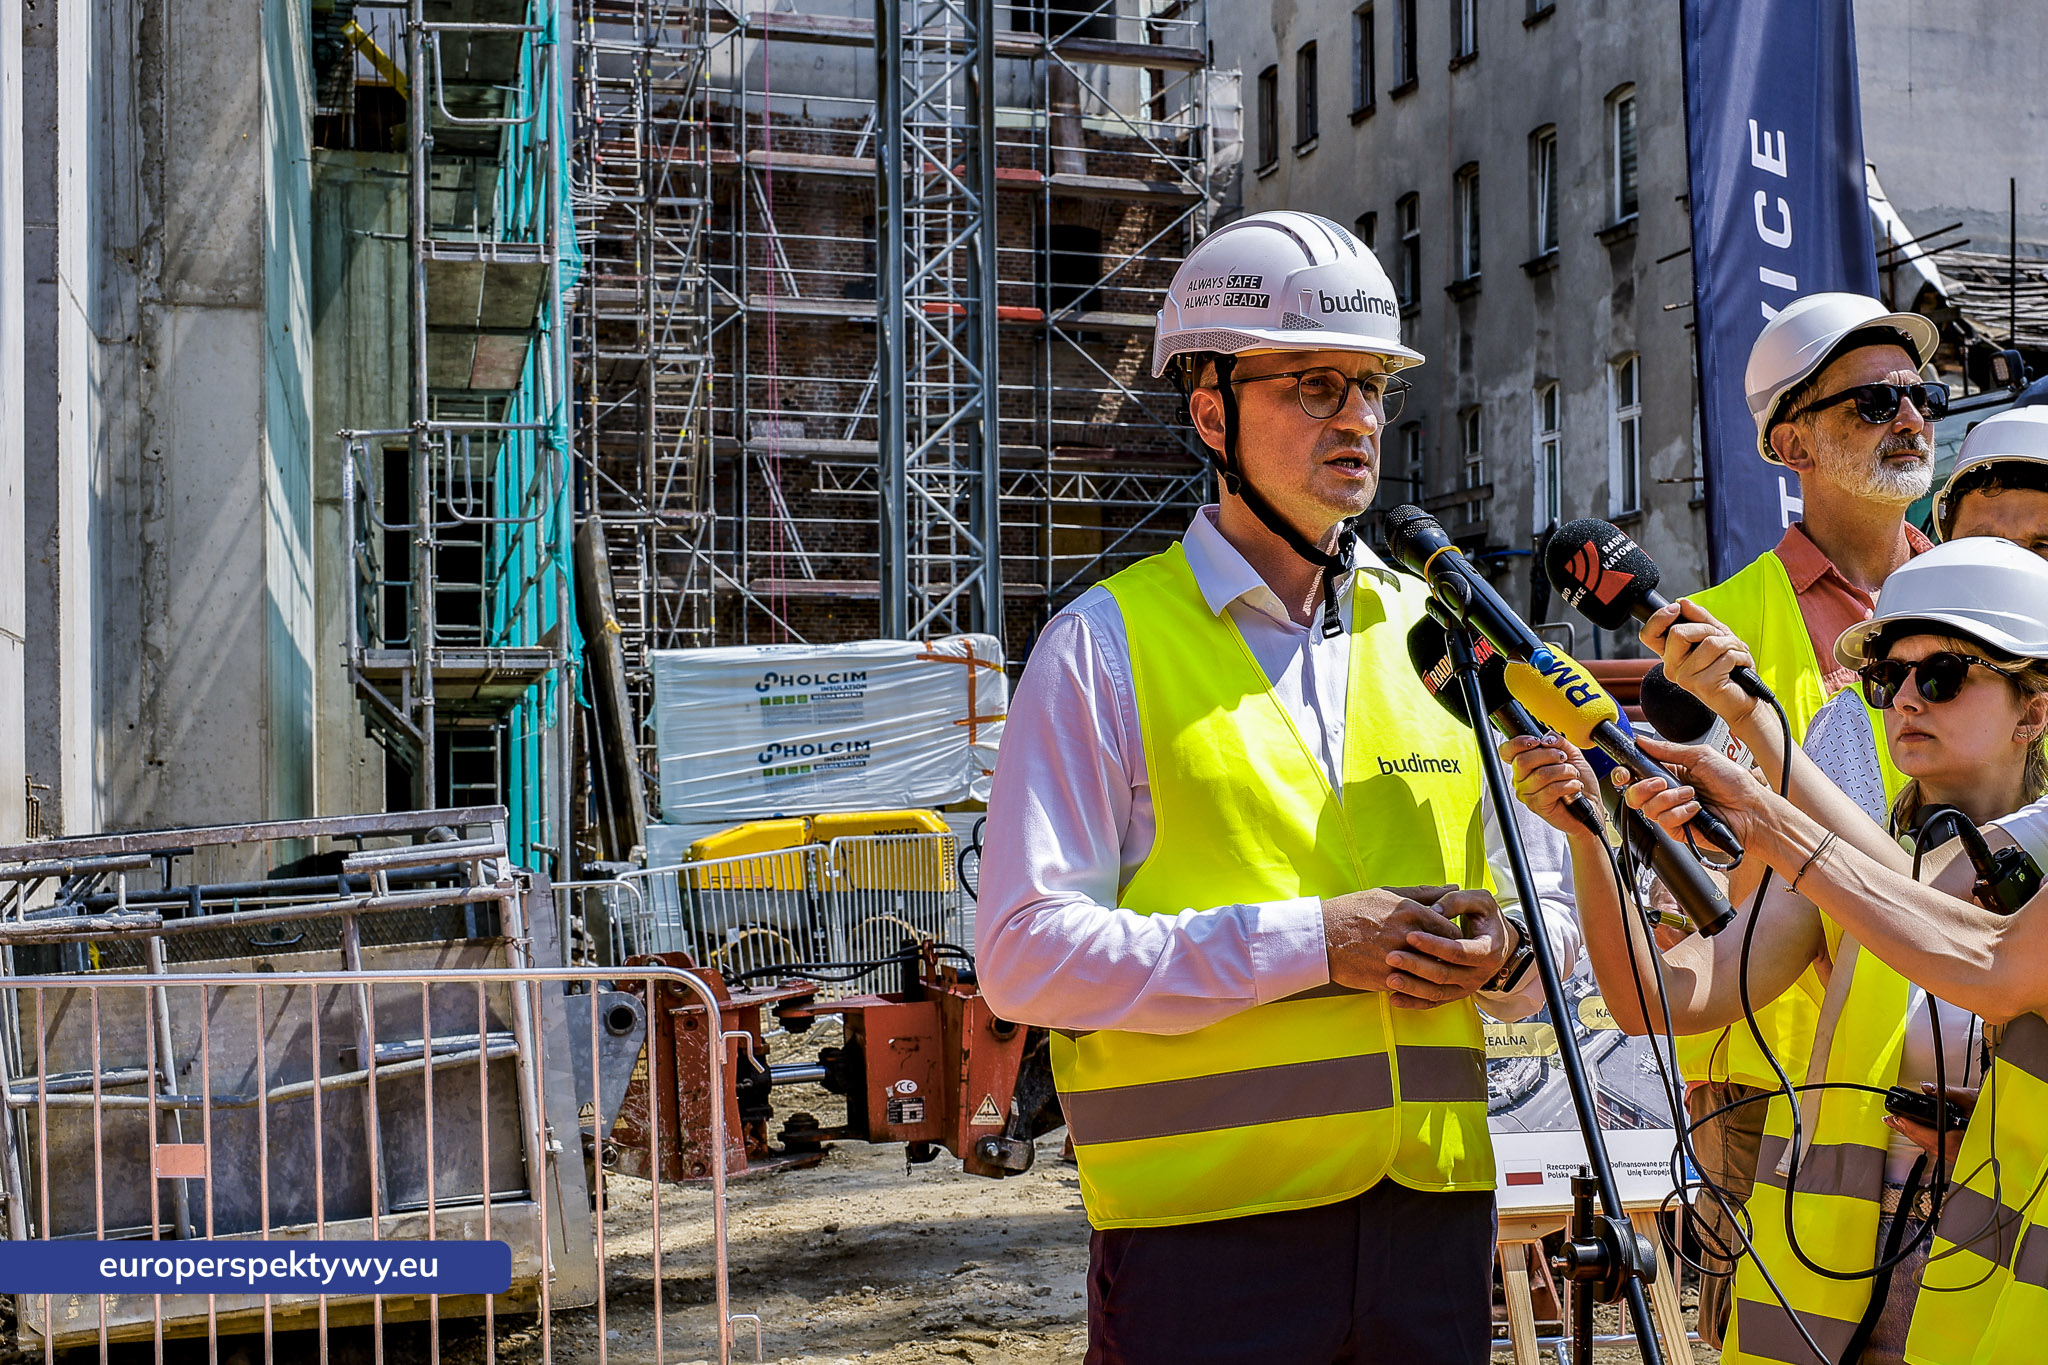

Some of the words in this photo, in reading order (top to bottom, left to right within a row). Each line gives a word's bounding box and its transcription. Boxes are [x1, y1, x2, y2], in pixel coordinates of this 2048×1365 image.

[1187, 276, 1224, 293] ALWAYS
[1227, 275, 1259, 288] SAFE
[1184, 293, 1220, 309] ALWAYS
[1223, 294, 1267, 308] READY
[1318, 288, 1398, 318] budimex
[780, 671, 867, 687] HOLCIM
[1541, 653, 1601, 708] RM
[784, 740, 871, 757] HOLCIM
[1377, 752, 1462, 775] budimex
[1547, 1171, 1570, 1179] Polska
